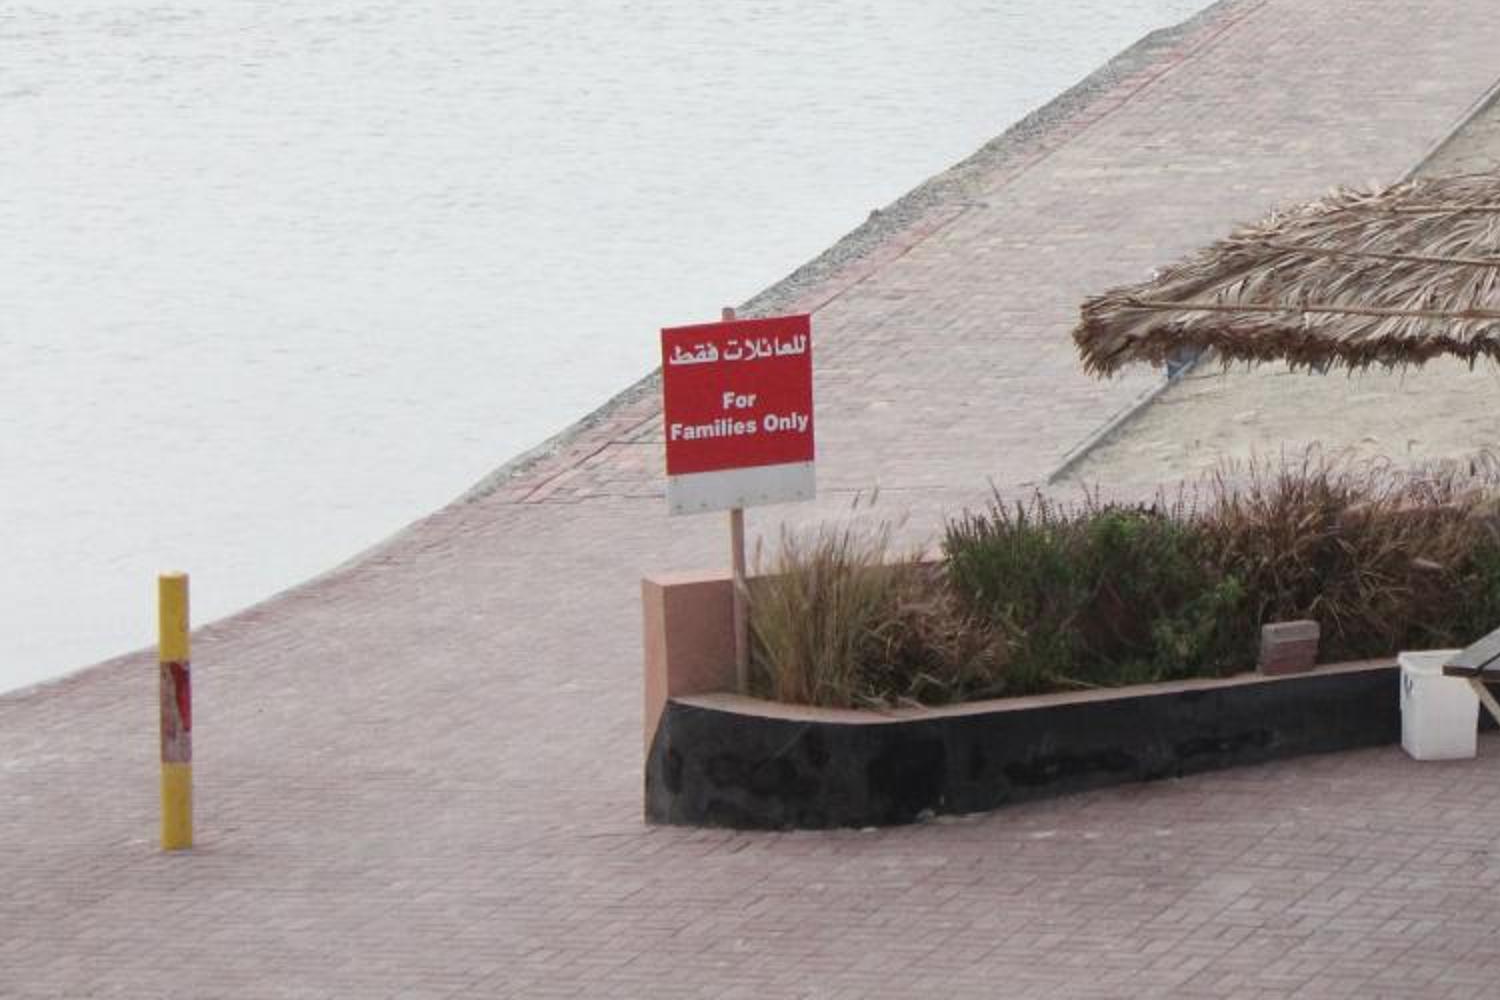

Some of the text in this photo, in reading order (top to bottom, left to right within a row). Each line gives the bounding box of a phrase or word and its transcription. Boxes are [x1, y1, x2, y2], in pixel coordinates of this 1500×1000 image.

[669, 343, 719, 365] فقط
[723, 391, 756, 409] For
[671, 412, 808, 441] Families Only
